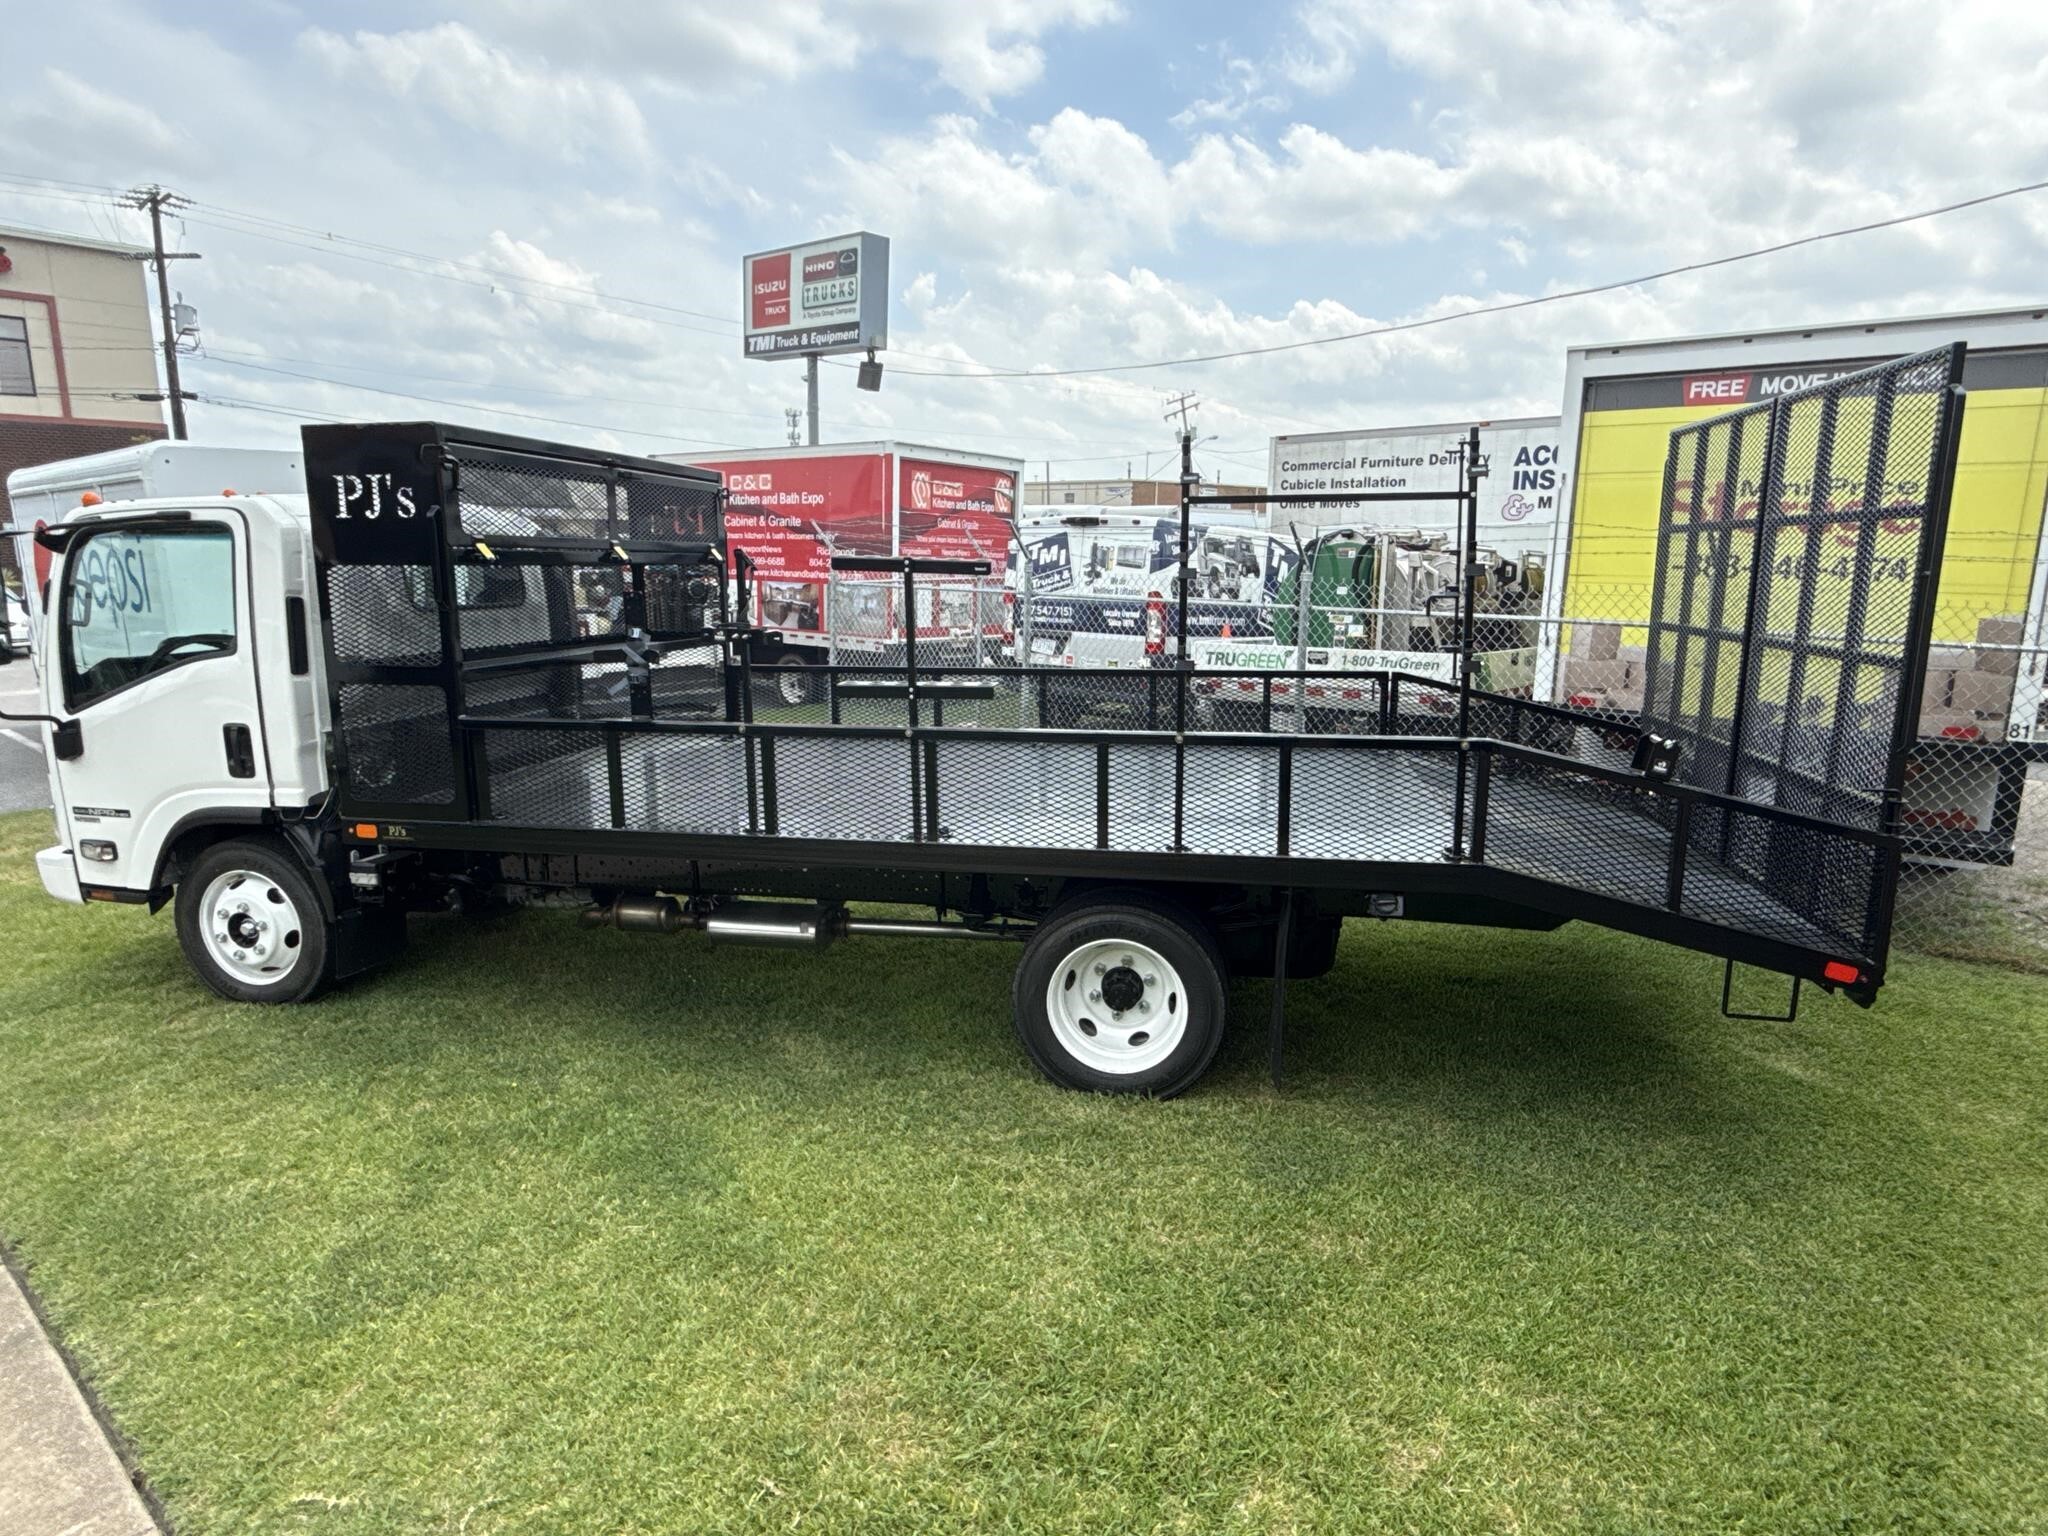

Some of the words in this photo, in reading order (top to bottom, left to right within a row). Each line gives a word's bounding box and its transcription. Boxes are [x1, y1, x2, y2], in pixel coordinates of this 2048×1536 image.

[754, 279, 787, 295] ISUZU
[804, 280, 854, 303] TRUCKS
[764, 306, 787, 316] TRUCK
[748, 334, 776, 352] TMI
[776, 334, 799, 348] Truck
[801, 333, 808, 345] &
[810, 328, 859, 346] Equipment
[1689, 378, 1744, 399] FREE
[1281, 457, 1356, 472] Commercial
[1360, 455, 1424, 470] Furniture
[729, 473, 772, 491] C&C
[1280, 478, 1327, 491] Cubicle
[1330, 475, 1407, 490] Installation
[1512, 469, 1555, 491] INS
[332, 473, 416, 519] PJ's
[729, 493, 760, 505] Kitchen
[762, 493, 779, 505] and
[779, 491, 800, 504] Bath
[801, 491, 824, 507] Expo
[1502, 494, 1535, 521] &
[724, 516, 757, 527] Cabinet
[759, 516, 766, 526] &
[768, 515, 802, 527] Granite
[816, 546, 856, 557] Ricmond
[1028, 542, 1066, 566] TMI
[1032, 574, 1060, 588] Truck
[1206, 651, 1287, 669] TRUGREEN
[1341, 655, 1440, 671] 1-800-TruGreen
[2009, 723, 2030, 739] 81
